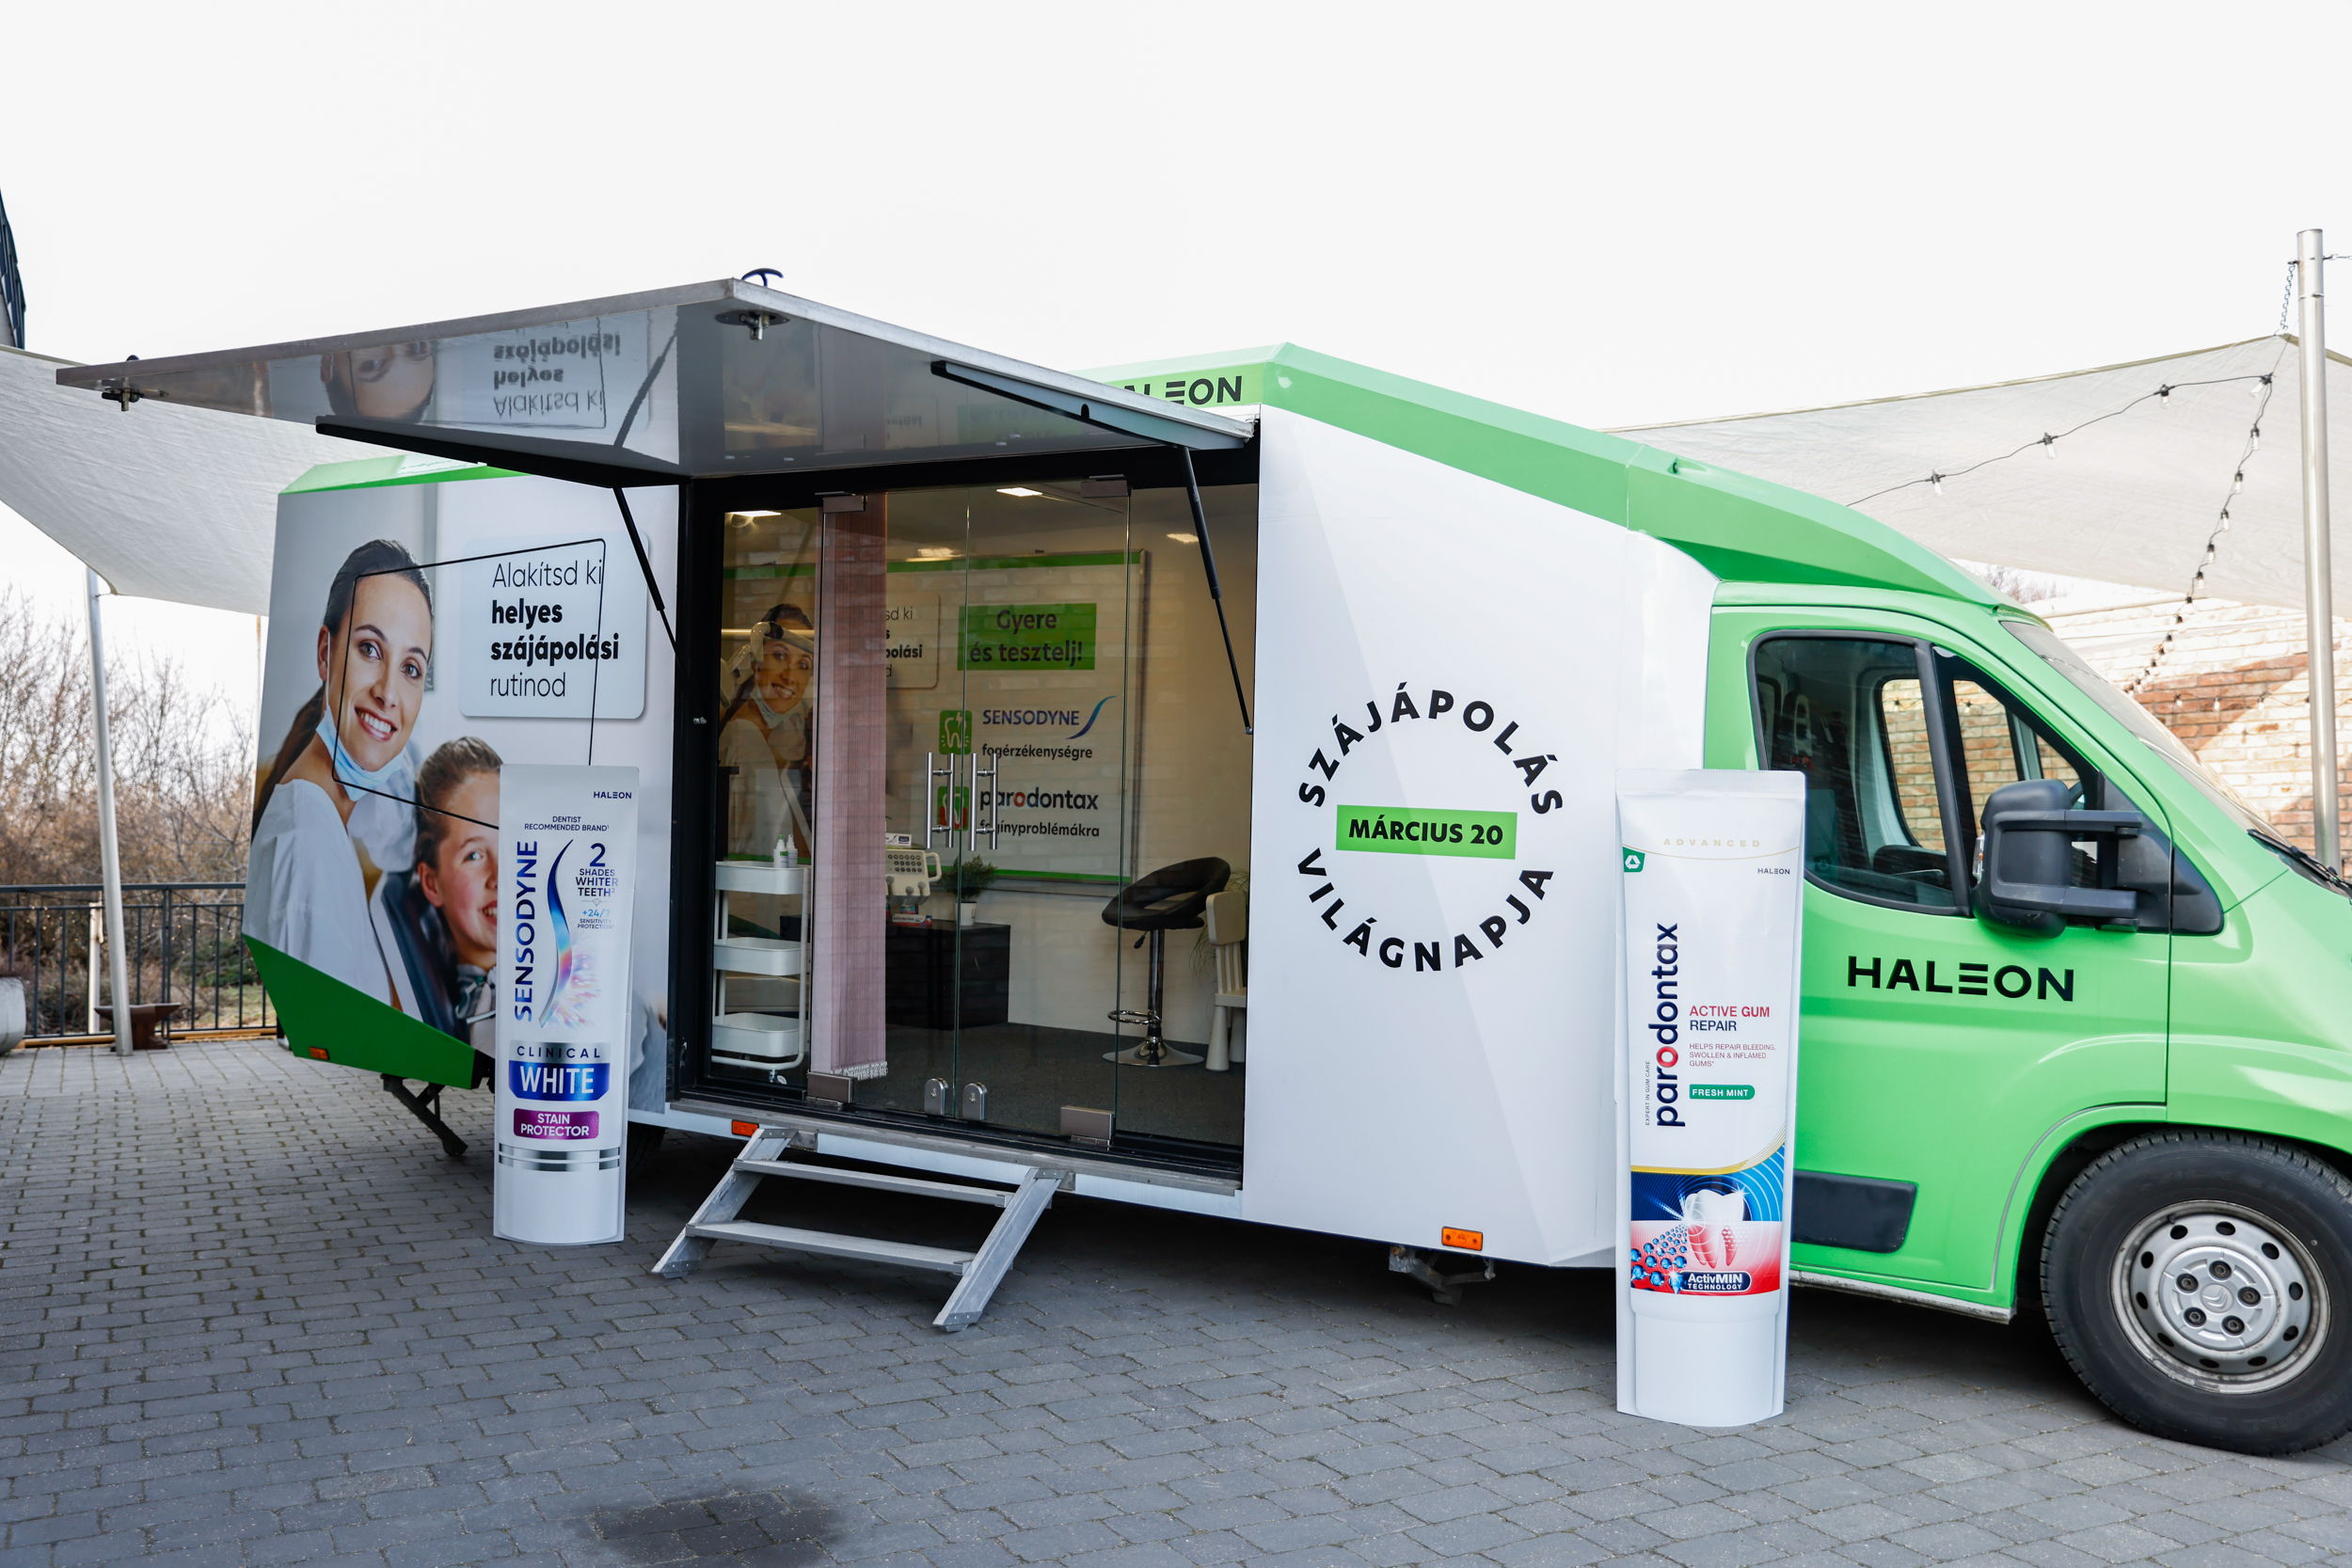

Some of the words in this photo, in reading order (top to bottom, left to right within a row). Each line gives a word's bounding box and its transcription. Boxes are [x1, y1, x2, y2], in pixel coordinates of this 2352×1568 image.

[492, 560, 578, 588] Alakítsd
[586, 559, 602, 585] ki
[492, 598, 563, 630] helyes
[996, 609, 1057, 634] Gyere
[490, 632, 619, 667] szájápolási
[969, 641, 993, 662] és
[998, 640, 1083, 667] tesztelj!
[490, 672, 565, 697] rutinod
[982, 709, 1080, 726] SENSODYNE
[982, 743, 1093, 761] fogérzékenységre
[1298, 681, 1564, 815] SZÁJÁPOLÁS
[593, 791, 632, 800] HALEON
[524, 823, 580, 832] RECOMMENDED
[1348, 814, 1463, 844] MÁRCIUS
[1470, 824, 1503, 846] 20
[1663, 838, 1760, 847] ADVANCED
[589, 843, 606, 867] 2
[579, 868, 615, 877] SHADES
[575, 876, 619, 887] WHITER
[582, 908, 611, 918] +24/7
[1297, 847, 1554, 973] VILÁGNAPJA
[515, 840, 538, 1022] SENSODYNE
[1847, 956, 2074, 1003] HALEON
[1689, 1005, 1738, 1018] ACTIVE
[1740, 1006, 1771, 1018] GUM
[1647, 922, 1686, 1128] parodontax
[1690, 1020, 1738, 1032] REPAIR
[516, 1045, 601, 1059] CLINICAL
[1742, 1043, 1776, 1052] BLEEDING,
[519, 1066, 595, 1095] WHITE
[1692, 1088, 1724, 1097] FRESH
[537, 1113, 570, 1125] STAIN
[520, 1125, 590, 1137] PROTECTOR
[1687, 1273, 1742, 1284] ActivMIN
